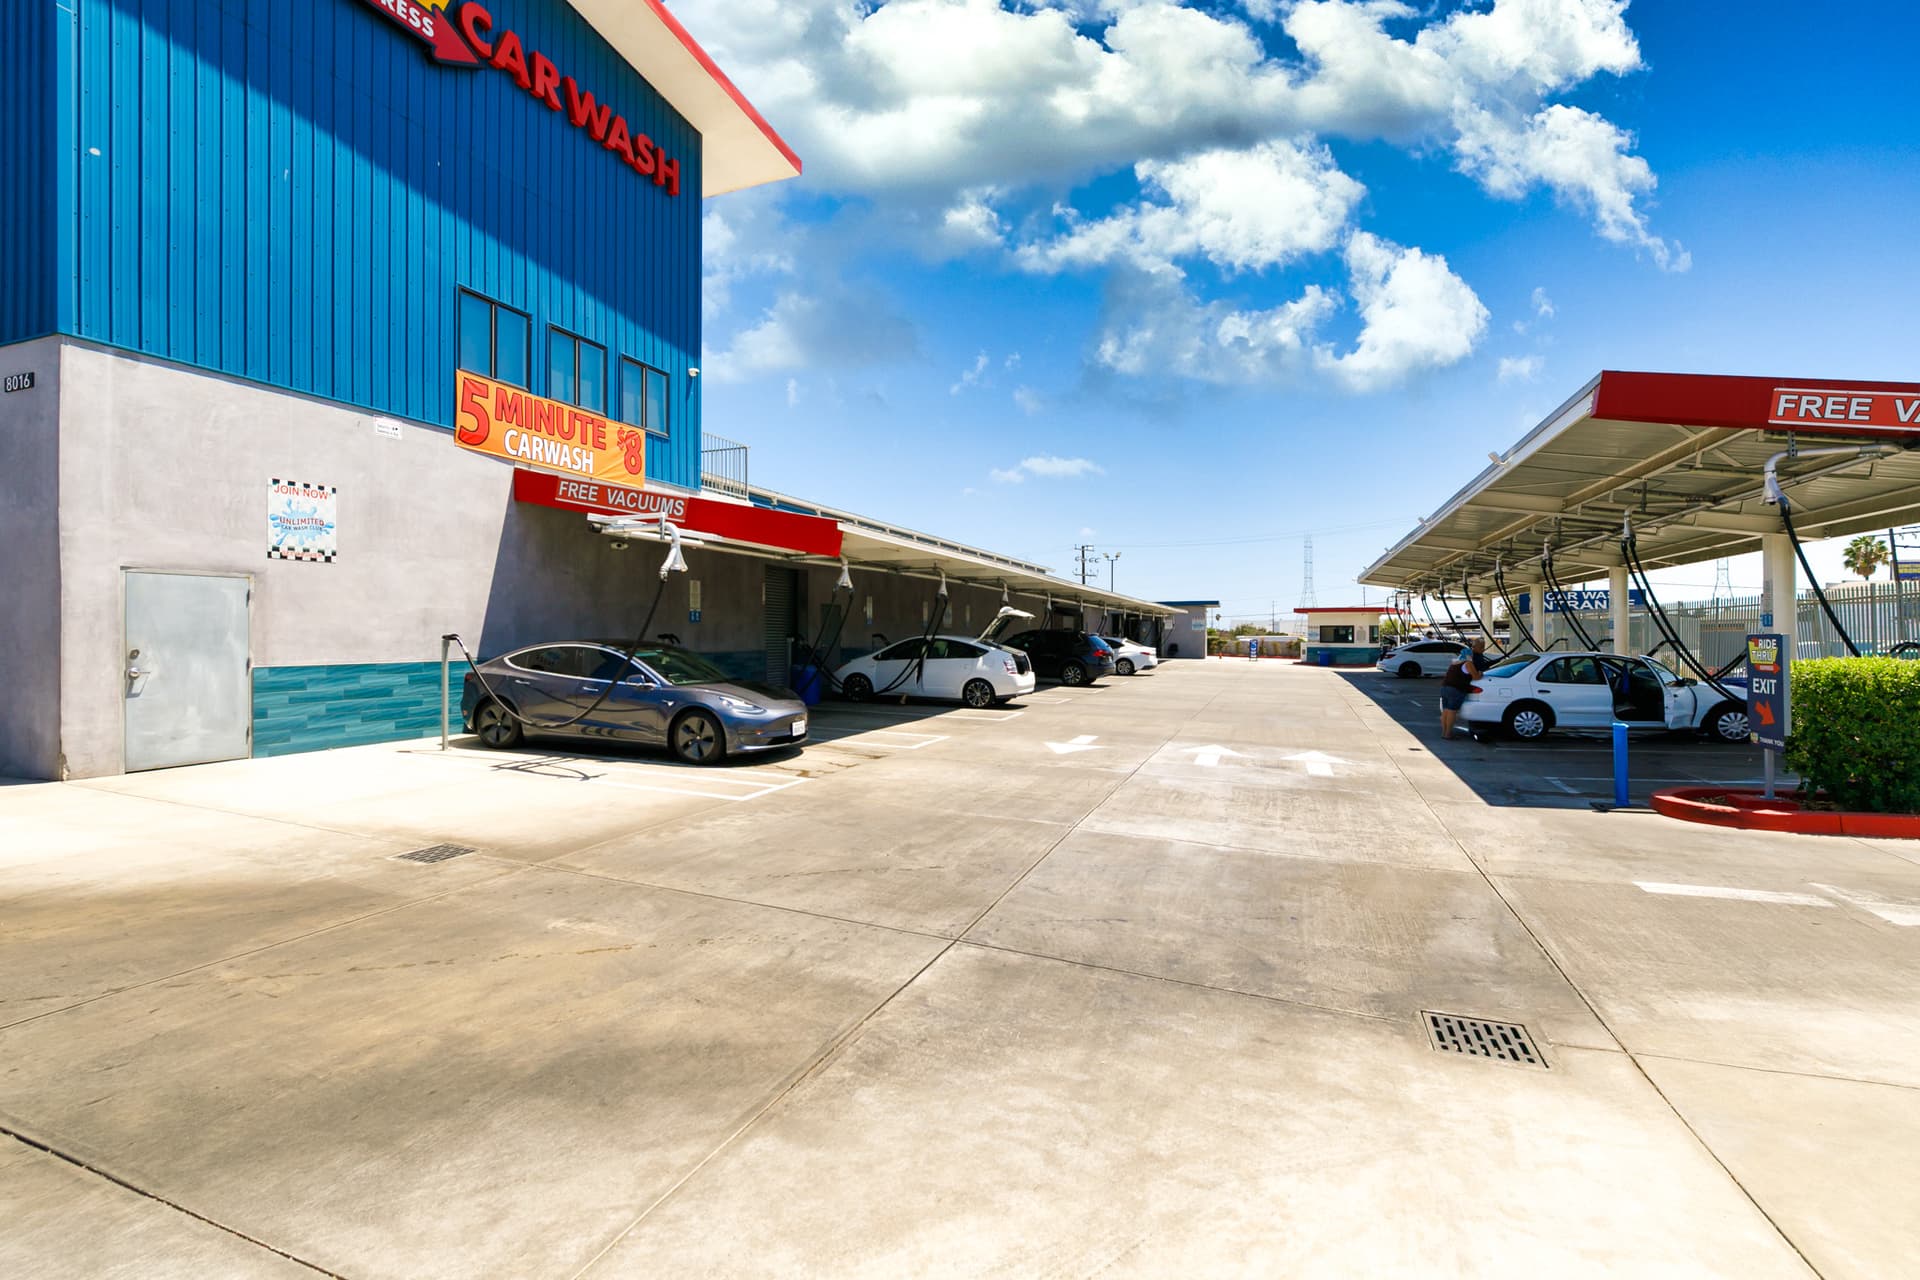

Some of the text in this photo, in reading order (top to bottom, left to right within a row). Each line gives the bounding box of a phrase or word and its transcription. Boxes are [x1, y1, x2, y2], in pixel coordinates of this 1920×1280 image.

[6, 373, 30, 391] 8016
[458, 378, 490, 446] 5
[495, 387, 607, 450] MINUTE
[1776, 394, 1920, 423] FREE V
[504, 429, 594, 474] CARWASH
[274, 485, 328, 500] JOIN NOW
[559, 480, 685, 516] FREE VACUUMS
[280, 516, 324, 526] UNLIMITED
[1545, 592, 1578, 601] CAR
[1758, 639, 1777, 649] RIDE
[1752, 650, 1773, 661] THRU
[1753, 678, 1777, 695] EXIT
